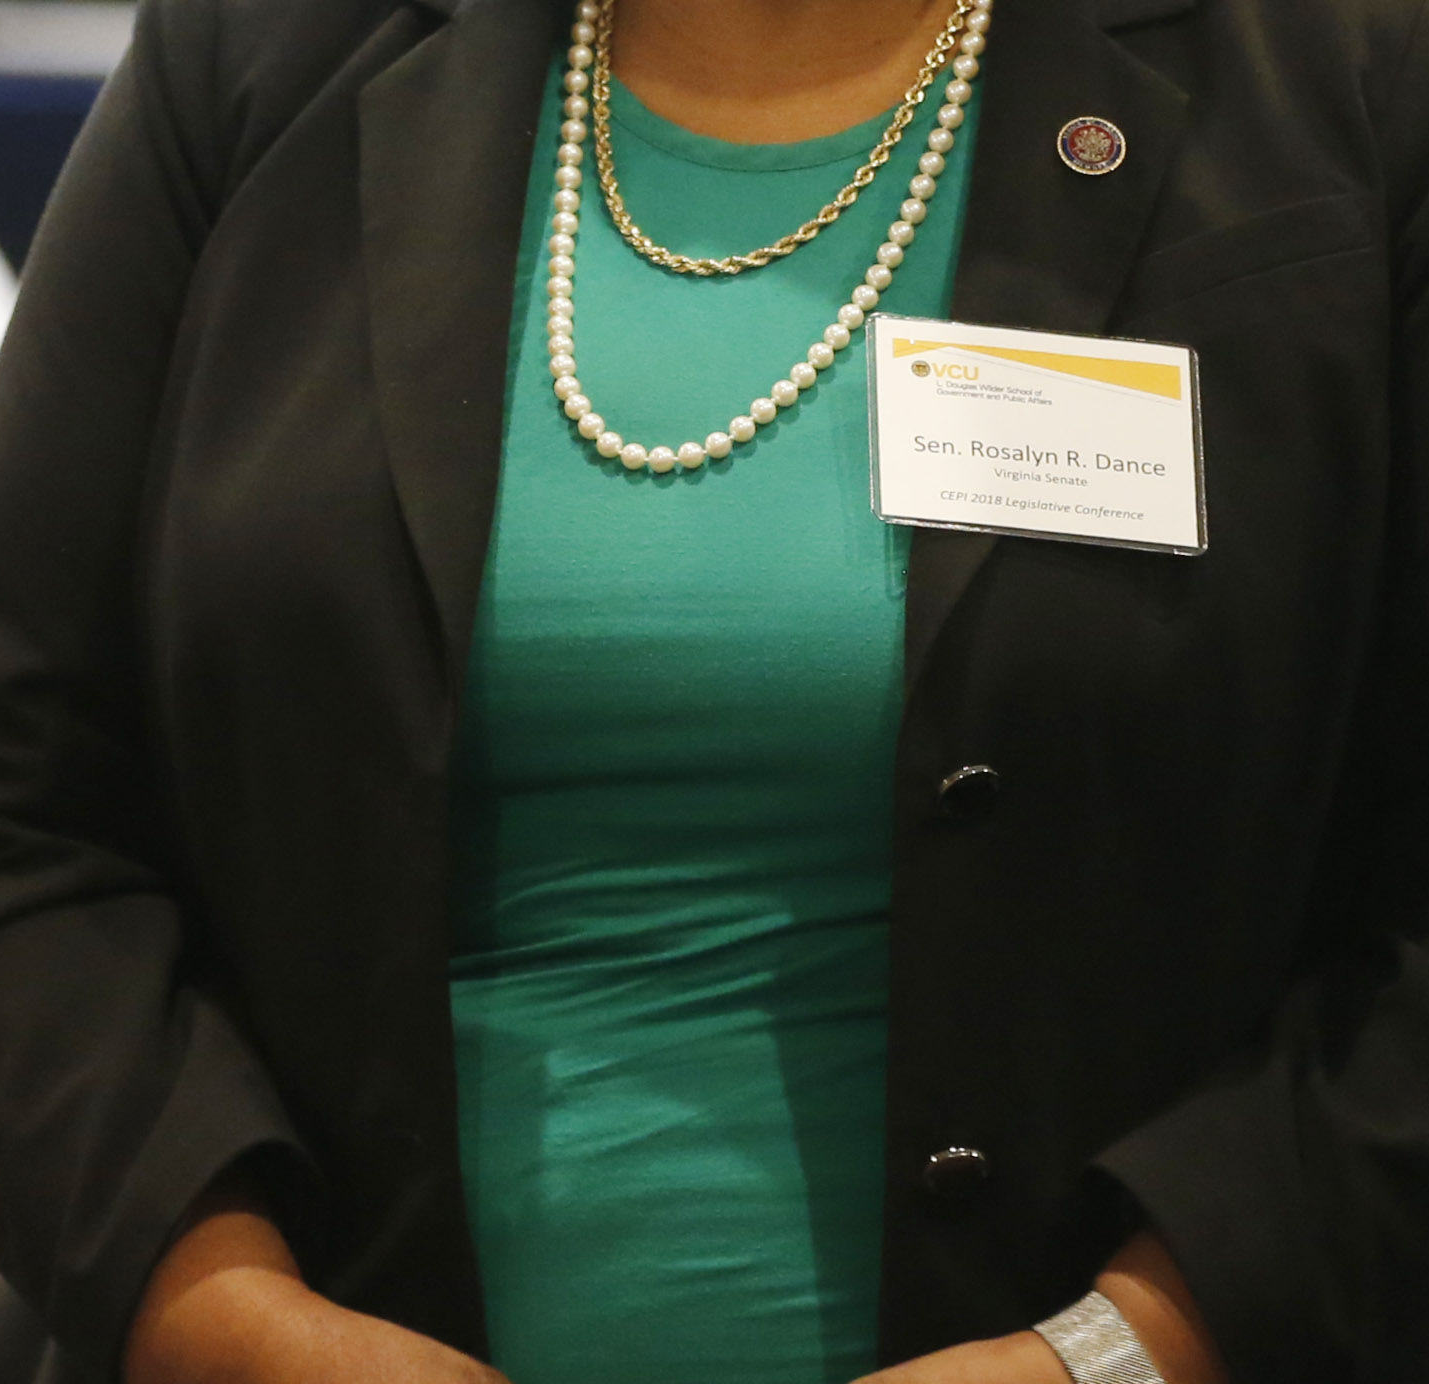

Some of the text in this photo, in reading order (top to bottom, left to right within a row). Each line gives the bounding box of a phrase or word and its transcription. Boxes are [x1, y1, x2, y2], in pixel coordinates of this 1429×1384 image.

[932, 362, 979, 381] VCU
[936, 388, 1052, 405] Government and Public Affairs
[946, 381, 977, 391] Douglas
[1006, 386, 1032, 396] School
[914, 435, 1166, 476] Sen. Rosalyn R. Dance
[994, 468, 1088, 487] Virginia Senate
[940, 490, 1145, 521] CEPI 2018 Legislative Conference
